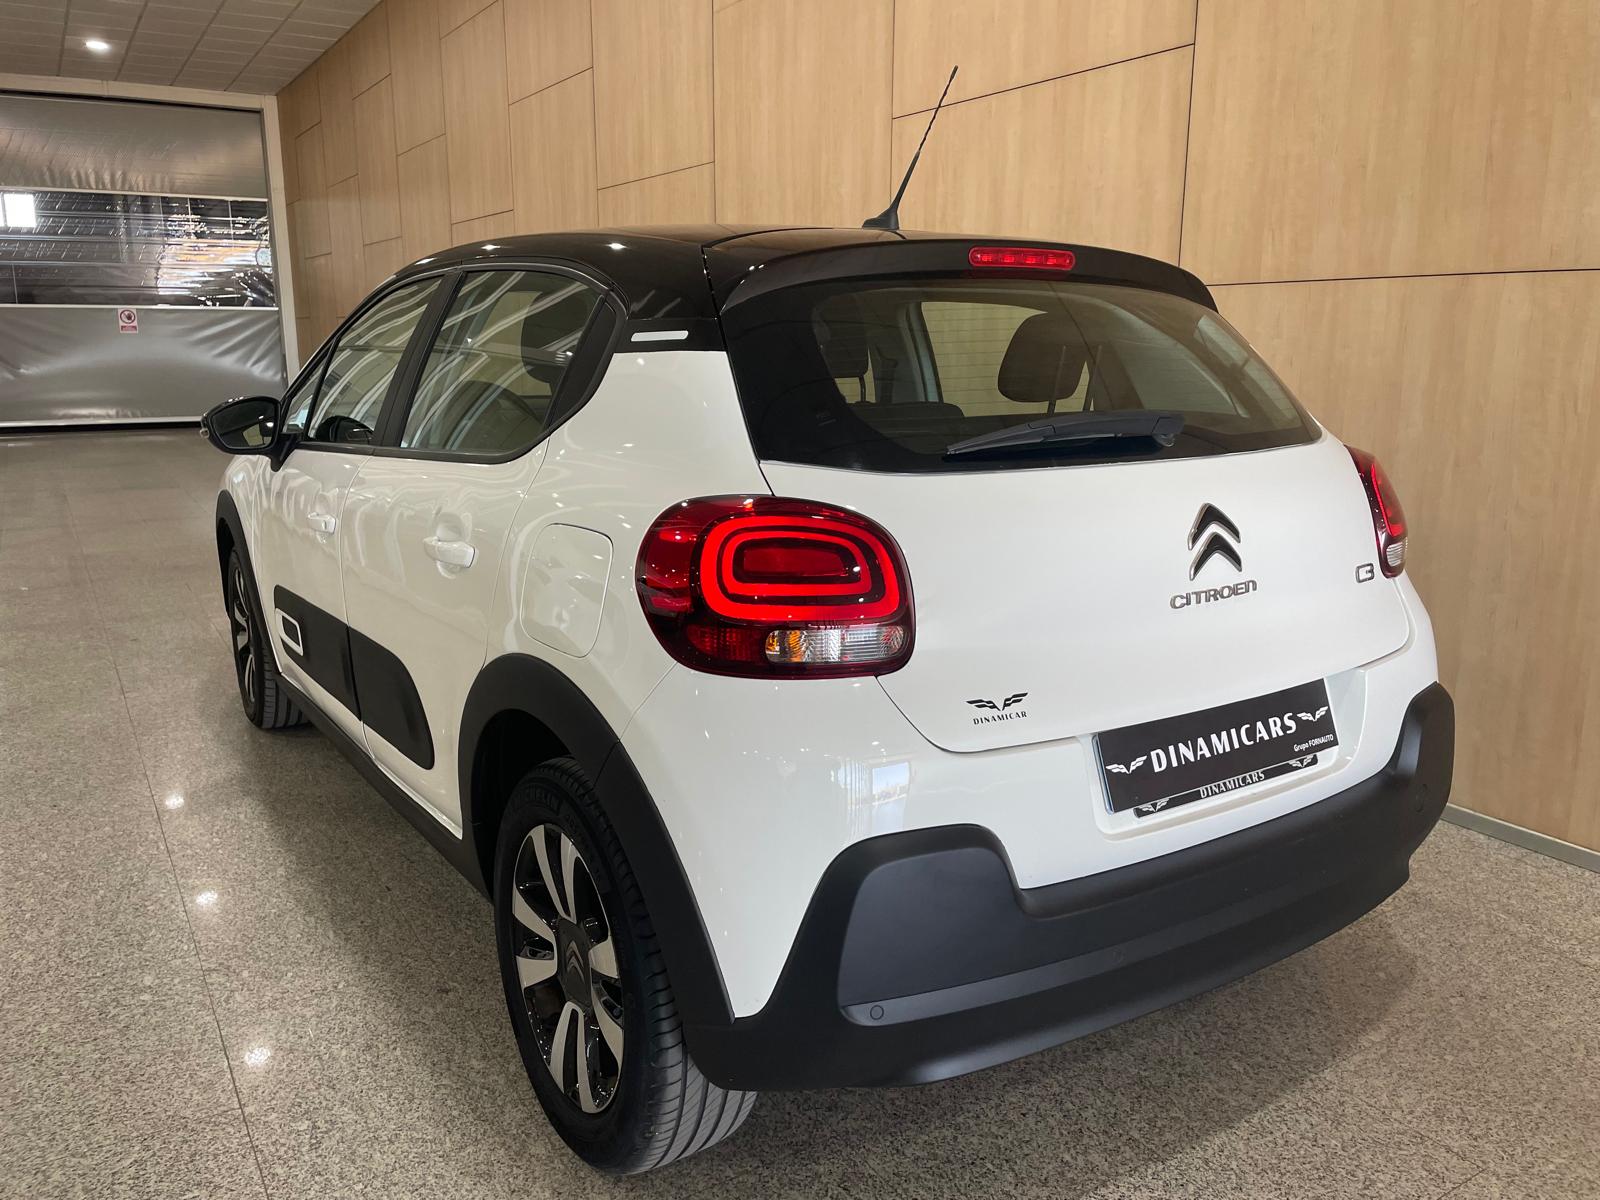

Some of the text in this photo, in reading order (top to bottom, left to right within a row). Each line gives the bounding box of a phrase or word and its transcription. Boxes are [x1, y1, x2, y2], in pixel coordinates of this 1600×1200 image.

[972, 710, 1028, 725] DINAMICAR
[1150, 712, 1297, 773] DINAMICARS
[1293, 743, 1309, 752] Grupo
[1200, 771, 1265, 799] DINAMICARS
